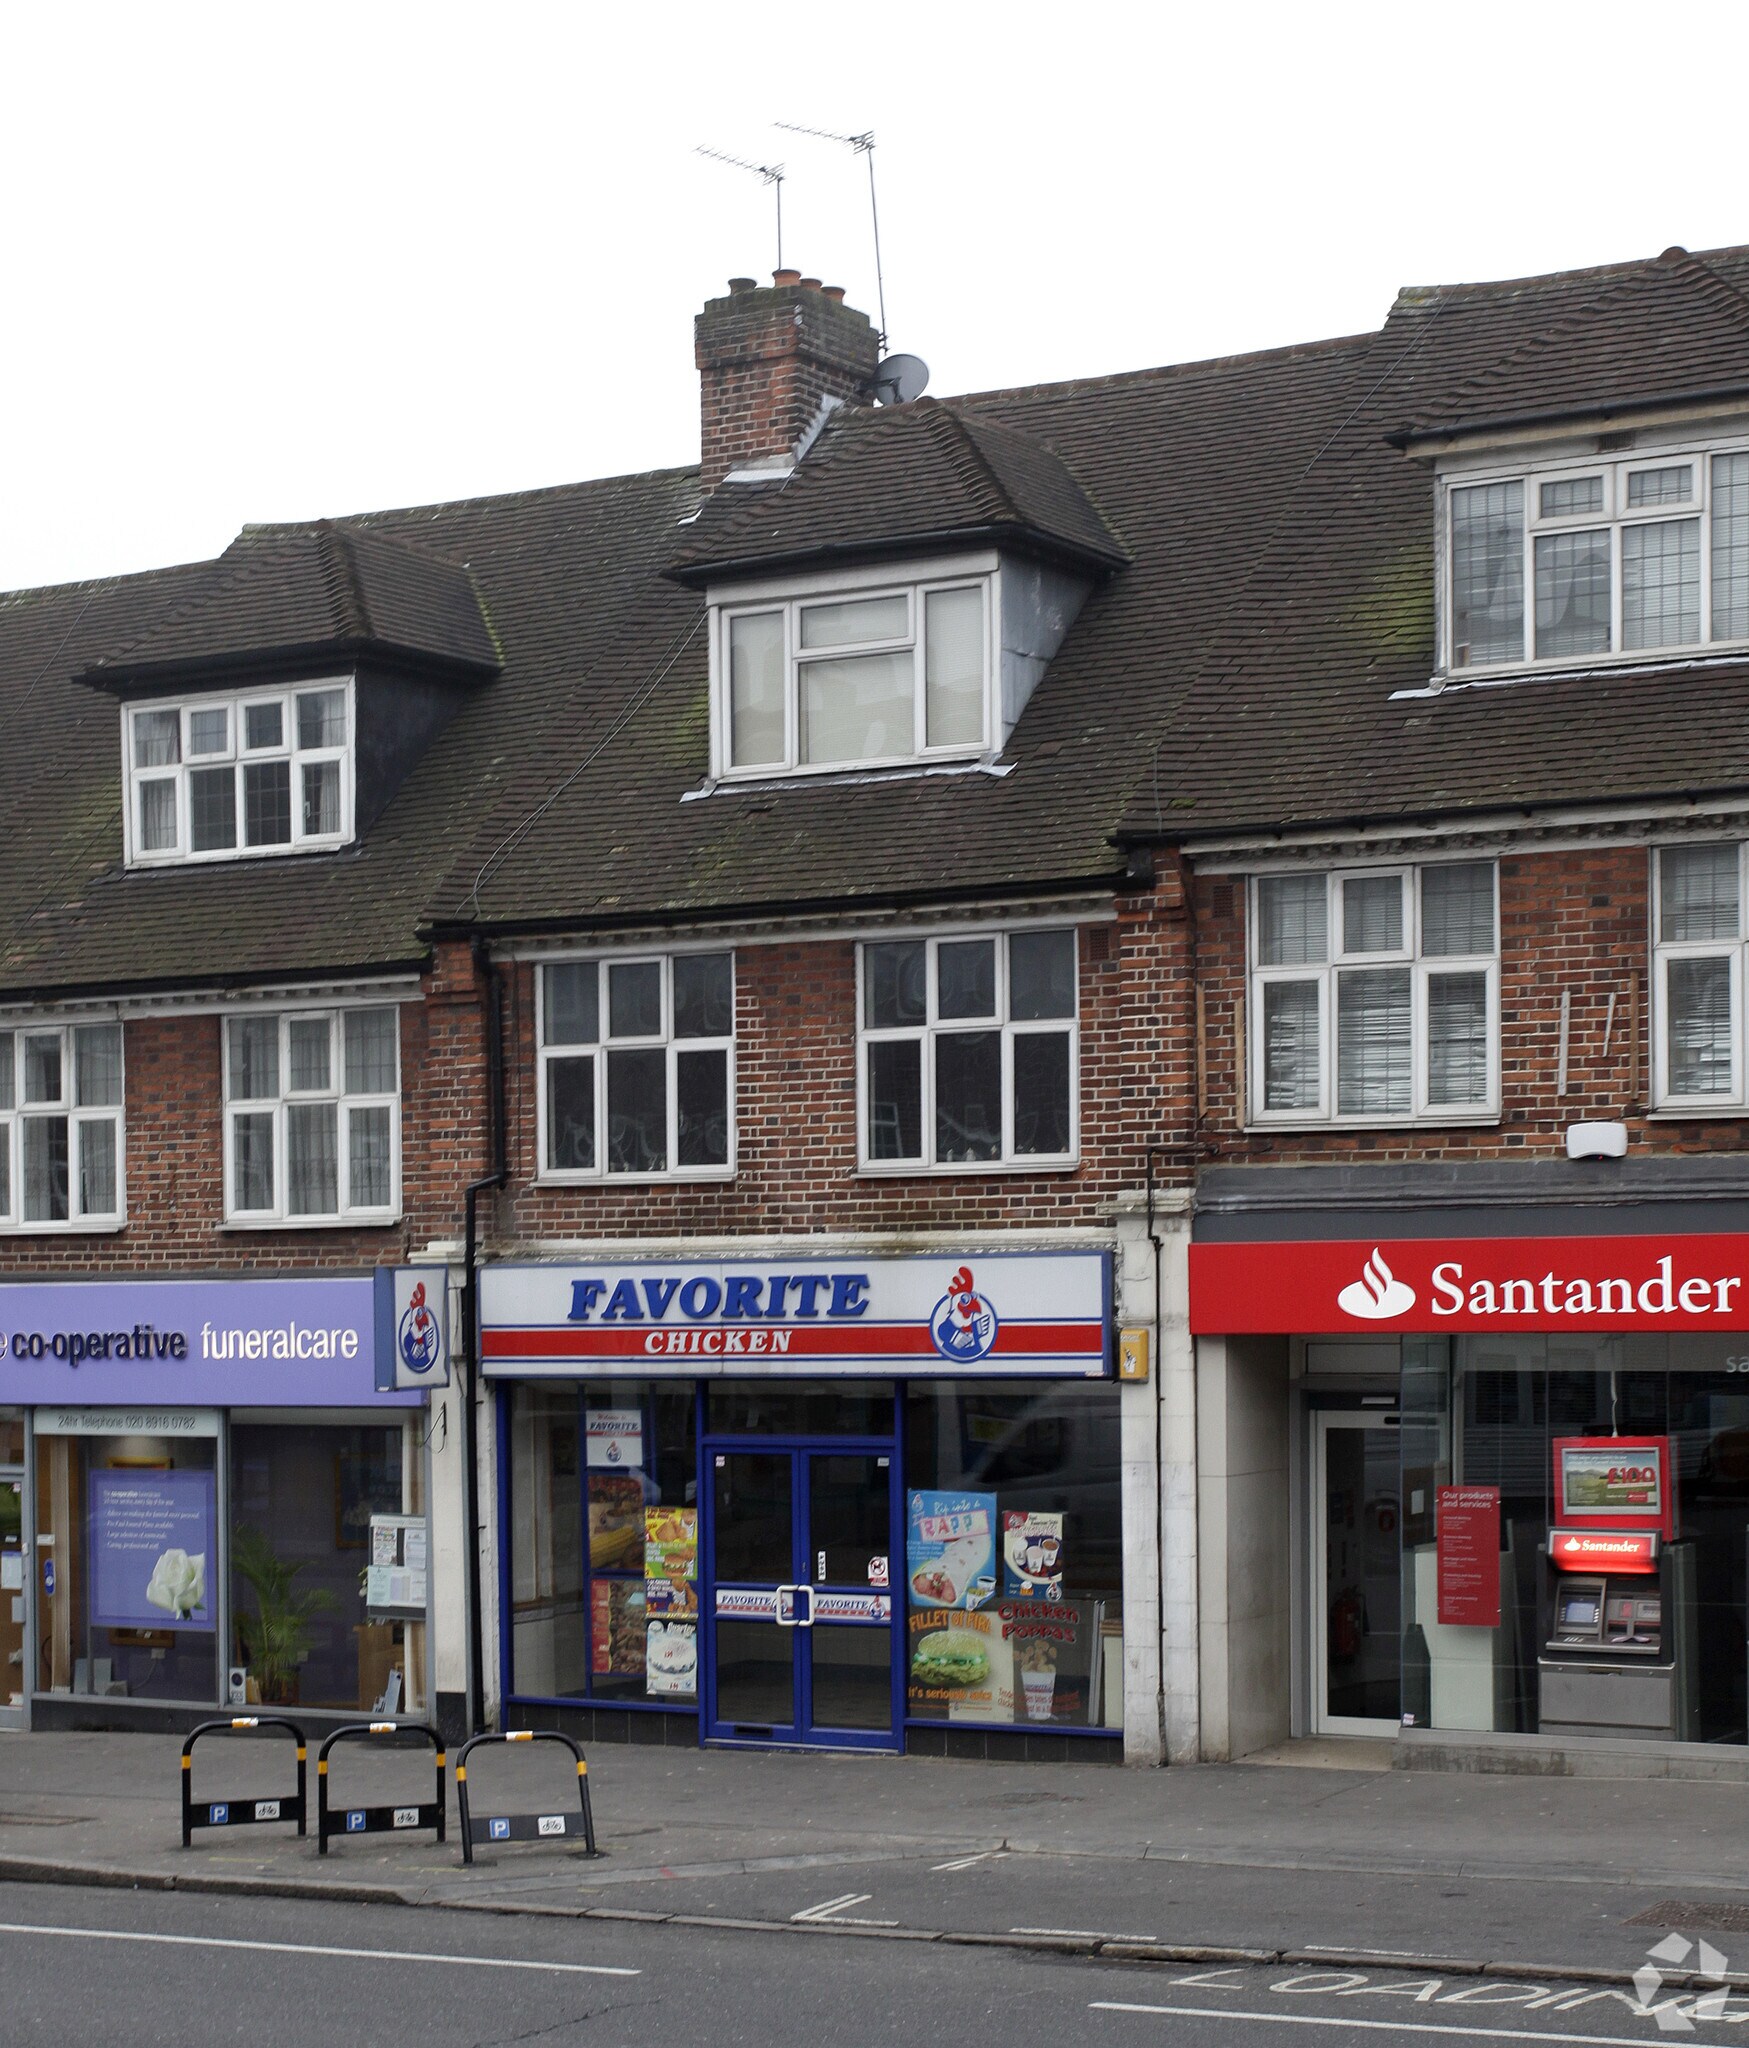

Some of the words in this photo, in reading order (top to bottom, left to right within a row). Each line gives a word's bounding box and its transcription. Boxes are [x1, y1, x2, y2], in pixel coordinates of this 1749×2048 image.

[1431, 1255, 1740, 1315] Santander
[567, 1274, 870, 1320] FAVORITE
[11, 1321, 188, 1368] co-operative
[200, 1321, 359, 1360] funeralcare
[644, 1330, 793, 1354] CHICKEN
[58, 1415, 78, 1428] 24hr
[81, 1415, 124, 1430] Telephone
[125, 1415, 144, 1429] 020
[145, 1415, 170, 1430] 8916
[590, 1421, 639, 1430] FAVORITE
[1607, 1466, 1656, 1485] £100
[1442, 1490, 1458, 1499] Our
[1459, 1491, 1494, 1501] products
[1442, 1499, 1459, 1508] and
[1459, 1501, 1492, 1509] services
[1581, 1539, 1640, 1553] Santander
[721, 1595, 772, 1606] FAVORITE
[817, 1600, 869, 1610] FAVORITE
[909, 1609, 949, 1633] FILLET
[998, 1601, 1079, 1625] Chicken
[1002, 1622, 1077, 1644] Poppas
[213, 1805, 226, 1822] P
[350, 1813, 363, 1830] P
[493, 1820, 507, 1837] P
